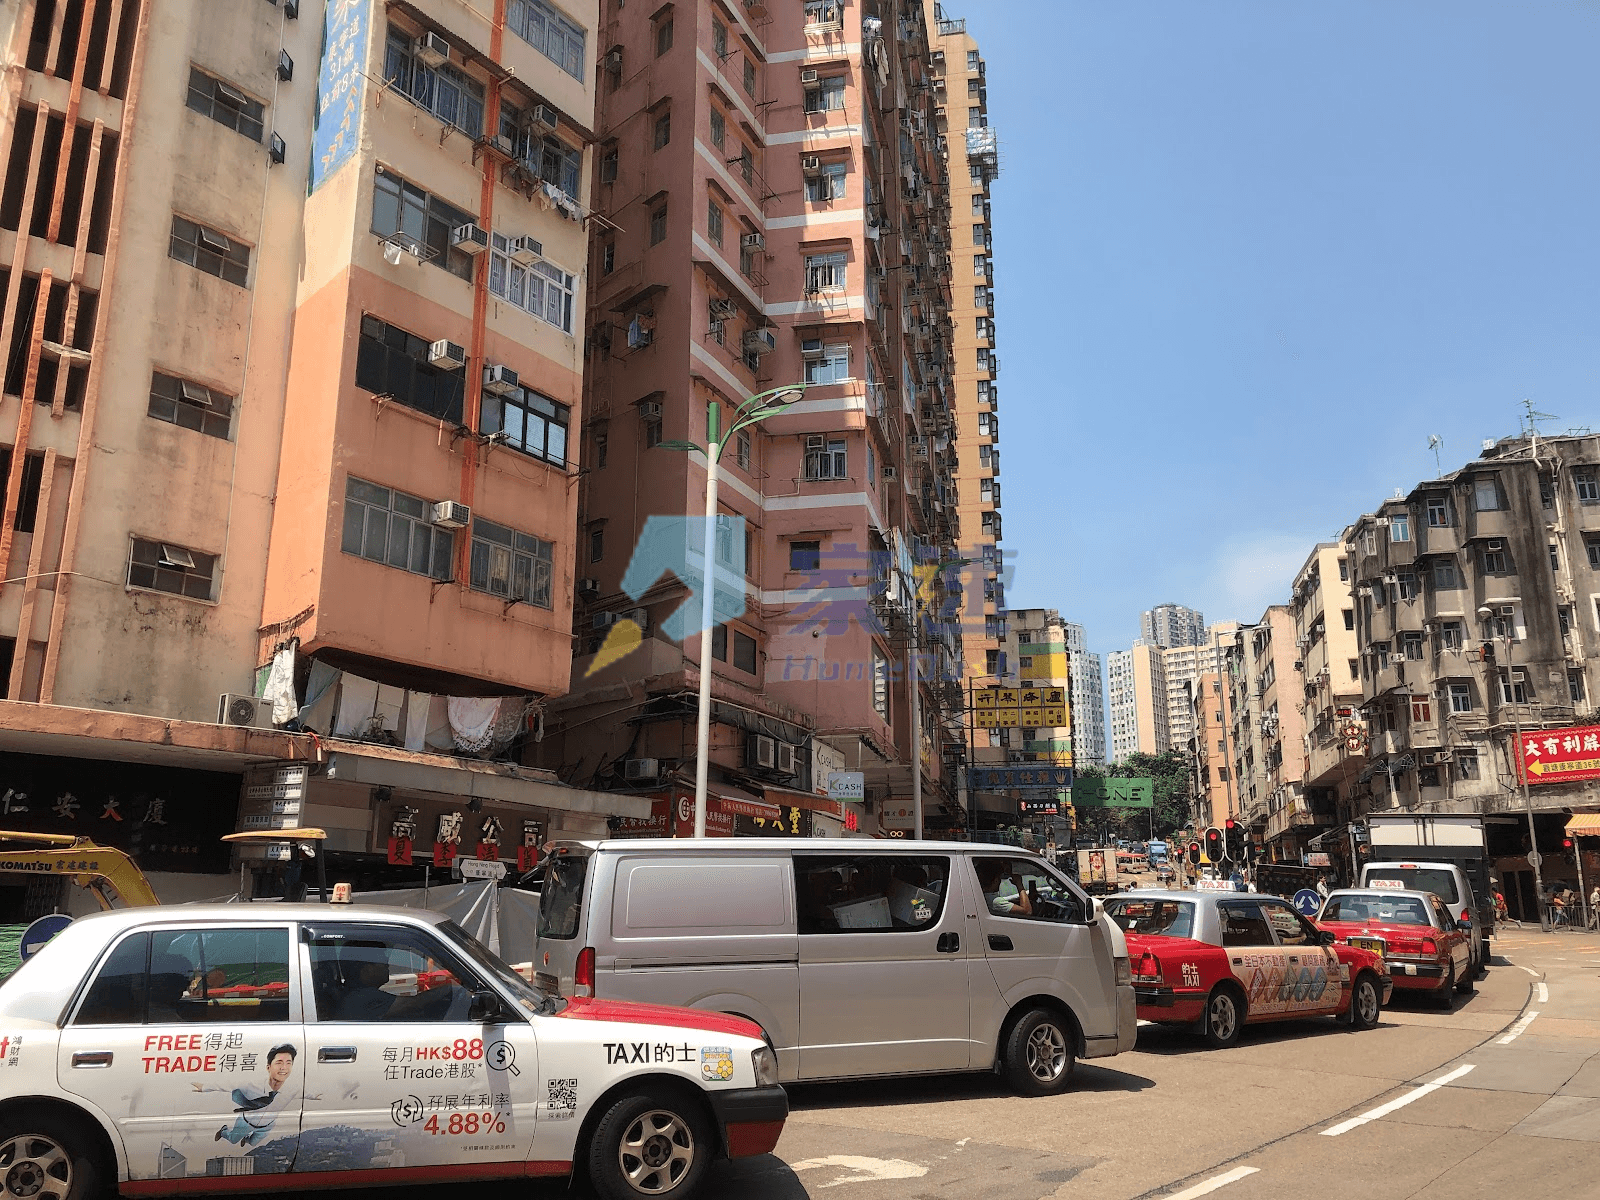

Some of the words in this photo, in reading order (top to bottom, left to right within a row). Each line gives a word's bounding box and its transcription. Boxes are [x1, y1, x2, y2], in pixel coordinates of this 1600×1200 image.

[3, 788, 168, 825] 仁安大廈
[1200, 881, 1229, 889] TAXI
[1372, 880, 1401, 888] TAXI
[1360, 941, 1373, 949] EN
[1181, 962, 1199, 975] 的士
[1182, 974, 1200, 987] TAXI
[8, 1035, 23, 1067] 鴻財網
[427, 1093, 511, 1111] 孖展年利率
